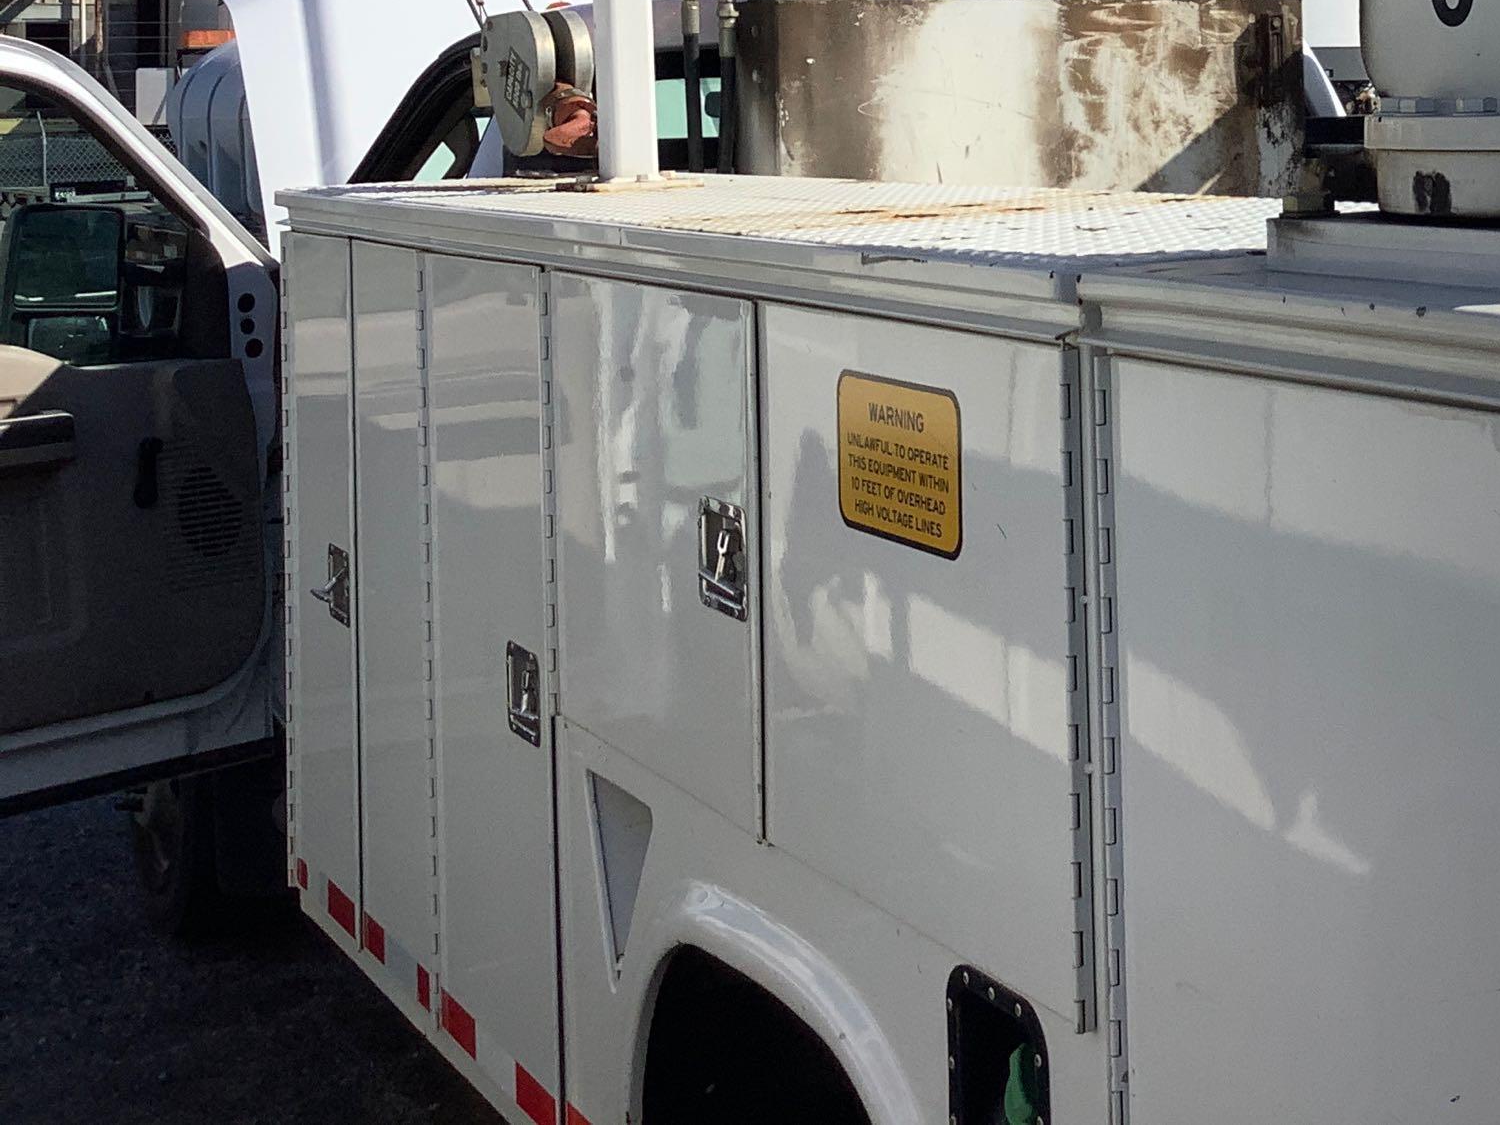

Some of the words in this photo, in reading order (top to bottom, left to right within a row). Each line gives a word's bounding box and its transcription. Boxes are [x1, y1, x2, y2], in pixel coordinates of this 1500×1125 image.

[869, 402, 924, 433] WARNING
[847, 432, 893, 457] UNLAWFUL
[894, 443, 906, 459] TO
[907, 447, 949, 471] OPERATE
[848, 453, 867, 471] THIS
[868, 459, 917, 484] EQUIPMENT
[918, 472, 949, 494] WITHIN
[851, 476, 860, 491] 10
[862, 479, 882, 496] FEET
[884, 486, 896, 500] OF
[897, 490, 946, 516] OVERHEAD
[855, 498, 875, 516] HIGH
[876, 504, 914, 530] VOLTAGE
[915, 517, 943, 538] LINES
